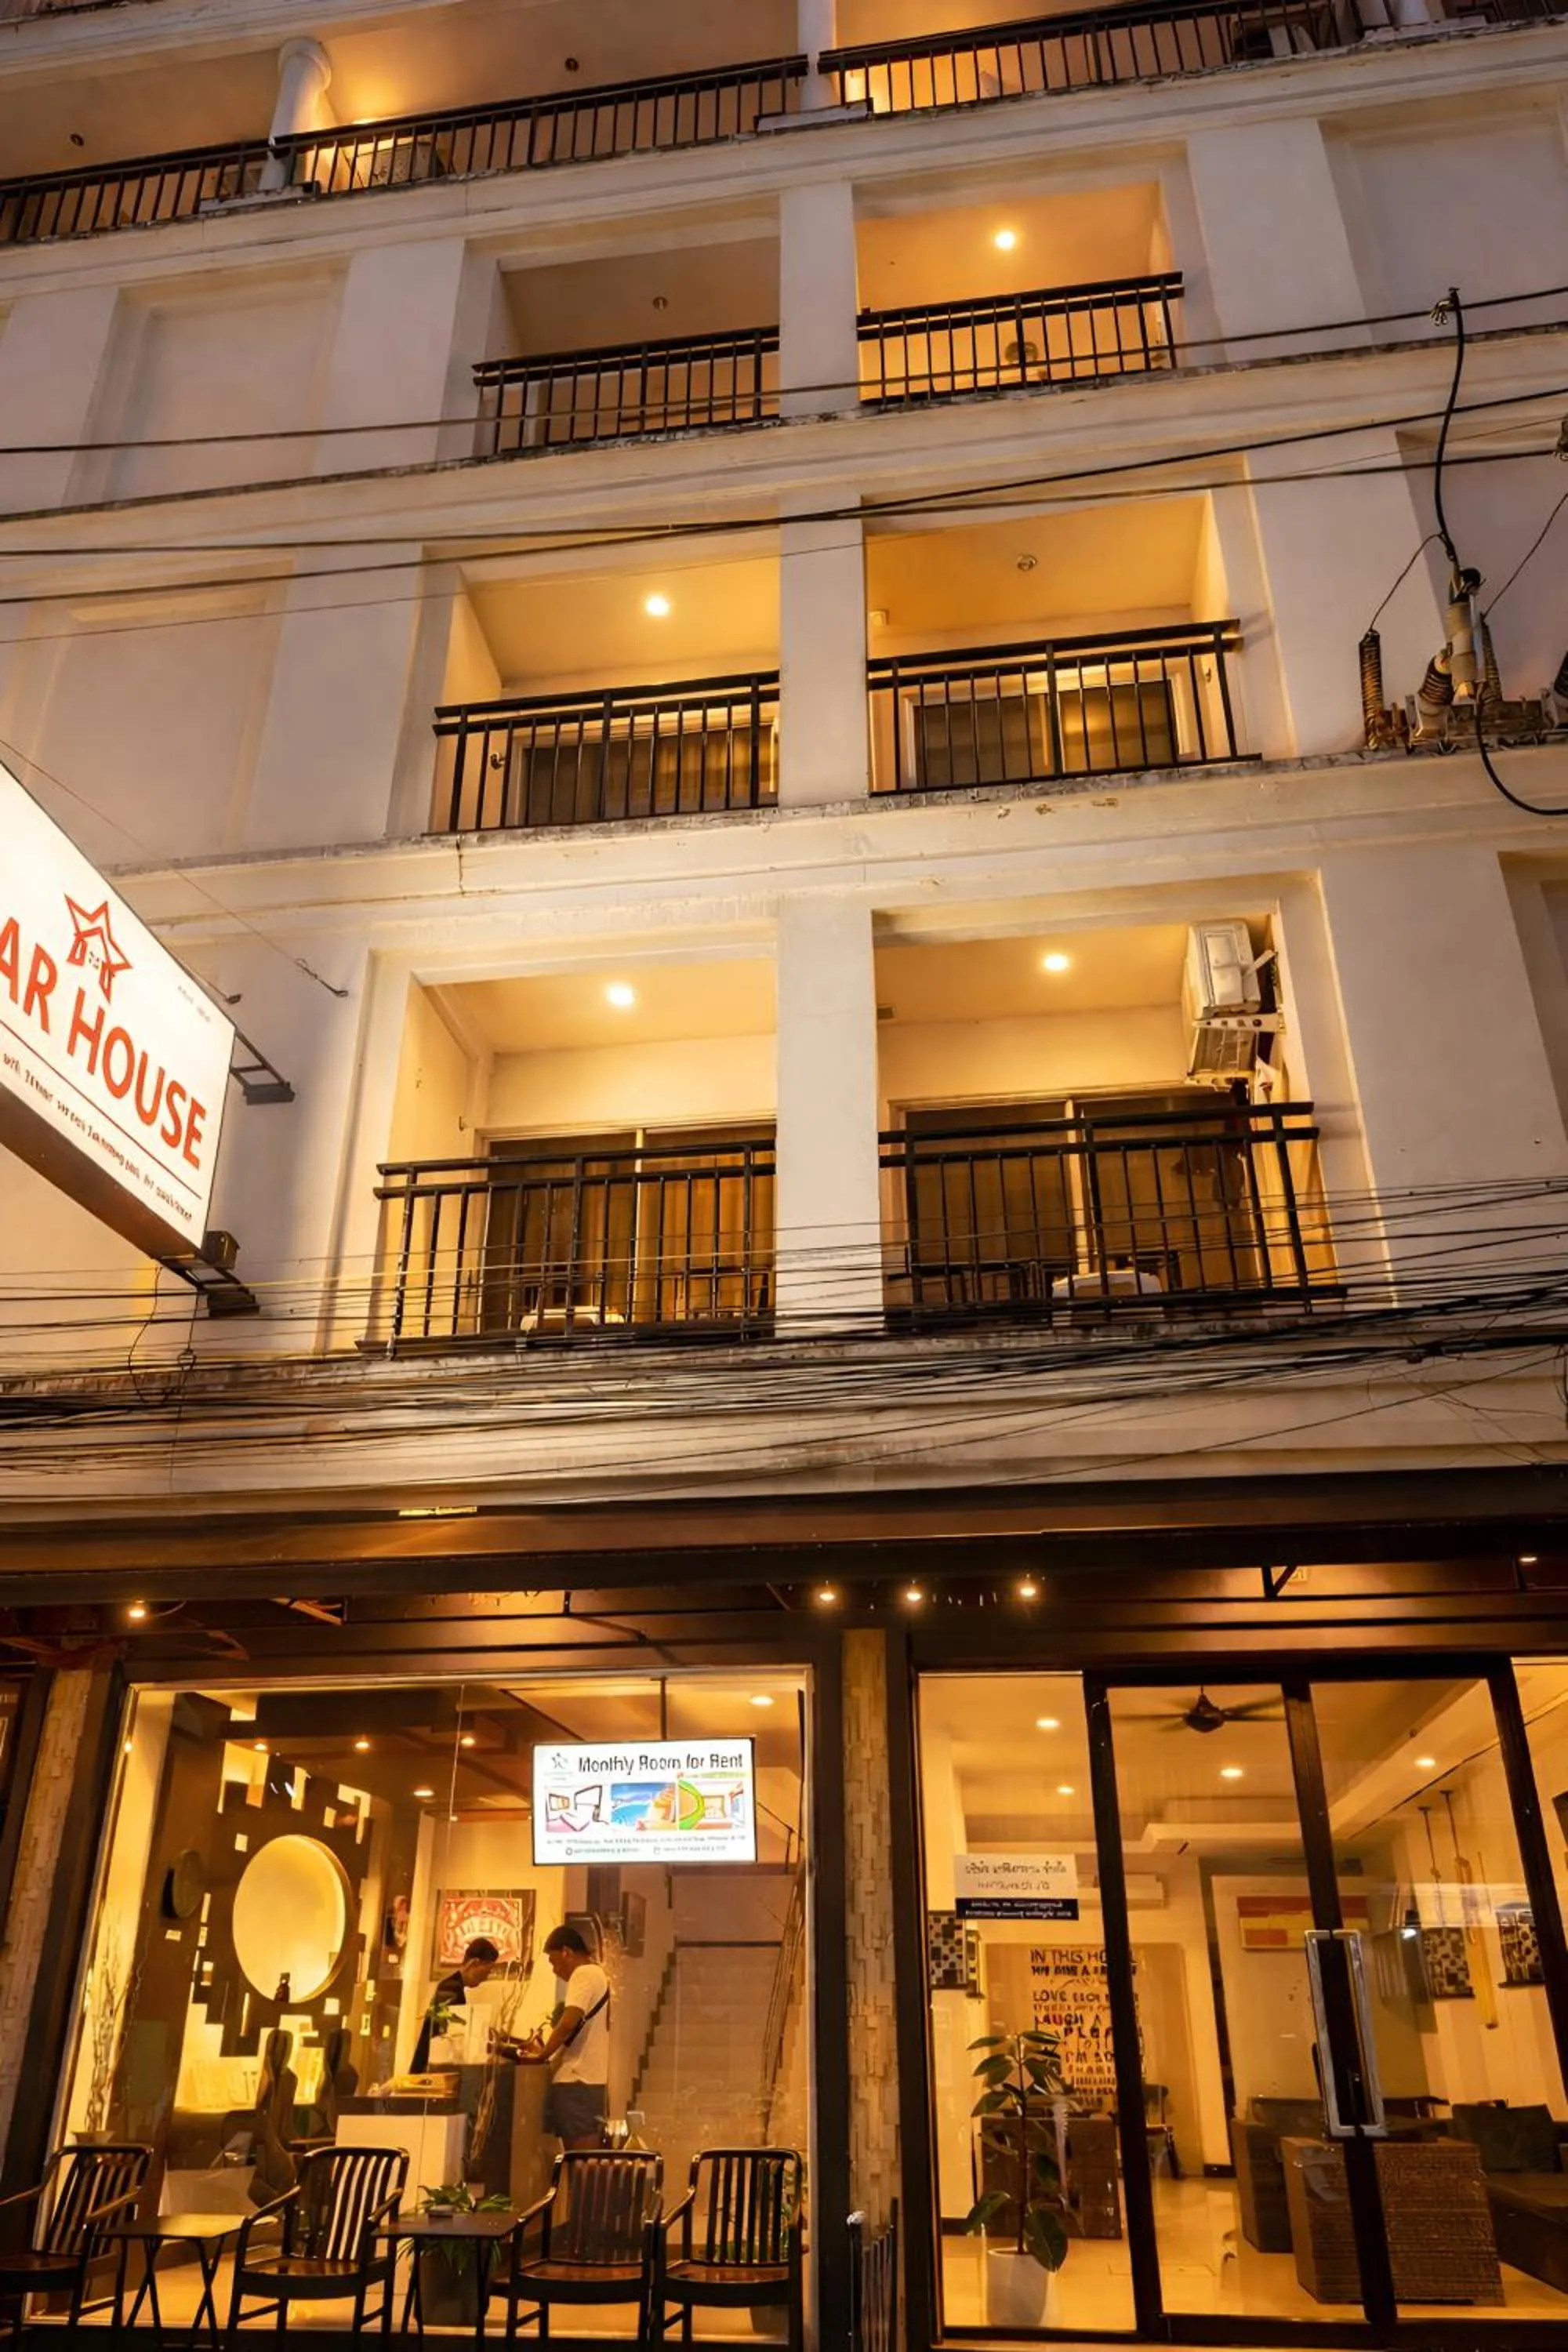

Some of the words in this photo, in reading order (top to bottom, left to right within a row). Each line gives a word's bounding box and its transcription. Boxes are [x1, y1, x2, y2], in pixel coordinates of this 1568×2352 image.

[67, 986, 207, 1171] HOUSE
[639, 1755, 681, 1770] Room
[686, 1753, 705, 1769] for
[710, 1753, 743, 1768] Rent
[1031, 1949, 1046, 1962] IN
[1051, 1948, 1083, 1964] THIS
